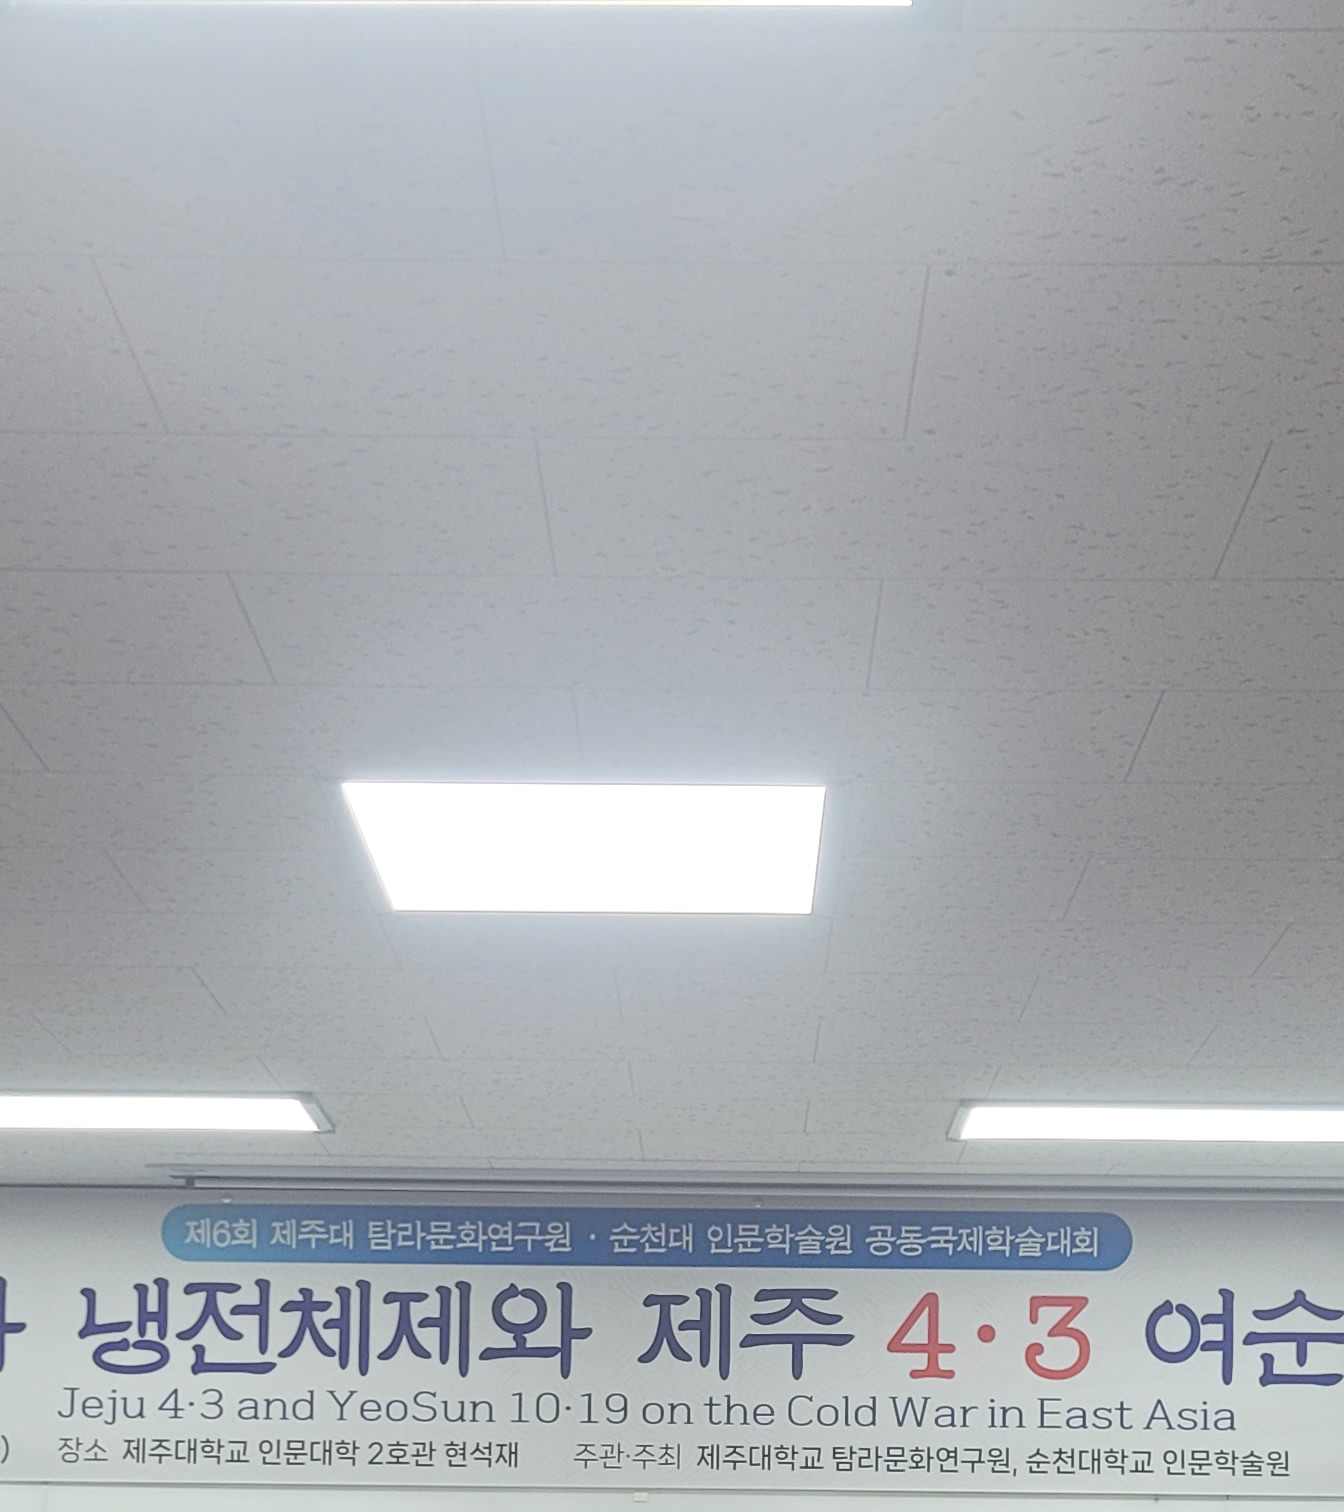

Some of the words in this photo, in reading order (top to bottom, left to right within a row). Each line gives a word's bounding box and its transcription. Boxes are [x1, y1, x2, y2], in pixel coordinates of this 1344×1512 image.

[184, 1219, 256, 1249] 제6회
[271, 1220, 352, 1249] 제주대
[368, 1220, 571, 1252] 탐라문화연구원
[610, 1223, 692, 1253] 순천대
[708, 1224, 852, 1254] 인문학술원
[866, 1226, 1097, 1257] 공동국제학술대회
[78, 1277, 593, 1380] 냉전체제와
[637, 1283, 855, 1380] 제주
[887, 1292, 1090, 1380] 4·3
[58, 1387, 145, 1425] Jeju
[158, 1388, 223, 1419] 4·3
[238, 1390, 314, 1420] and
[327, 1391, 496, 1422] YeoSun
[511, 1393, 627, 1424] 10·19
[643, 1403, 693, 1424] on
[704, 1395, 774, 1425] the
[788, 1395, 876, 1426] Cold
[889, 1397, 978, 1427] War
[988, 1399, 1025, 1428] in
[1038, 1398, 1133, 1429] East
[1143, 1399, 1236, 1430] Asia
[58, 1437, 108, 1463] 장소
[123, 1438, 249, 1465] 제주대학교
[259, 1440, 360, 1466] 인문대학
[368, 1441, 436, 1467] 2호관
[445, 1441, 518, 1468] 현석재
[574, 1443, 680, 1469] 주관·주최
[697, 1444, 824, 1471] 제주대학교
[833, 1446, 1016, 1476] 탐라문화연구원,
[1026, 1448, 1154, 1475] 순천대학교
[1163, 1450, 1289, 1476] 인문학술원
